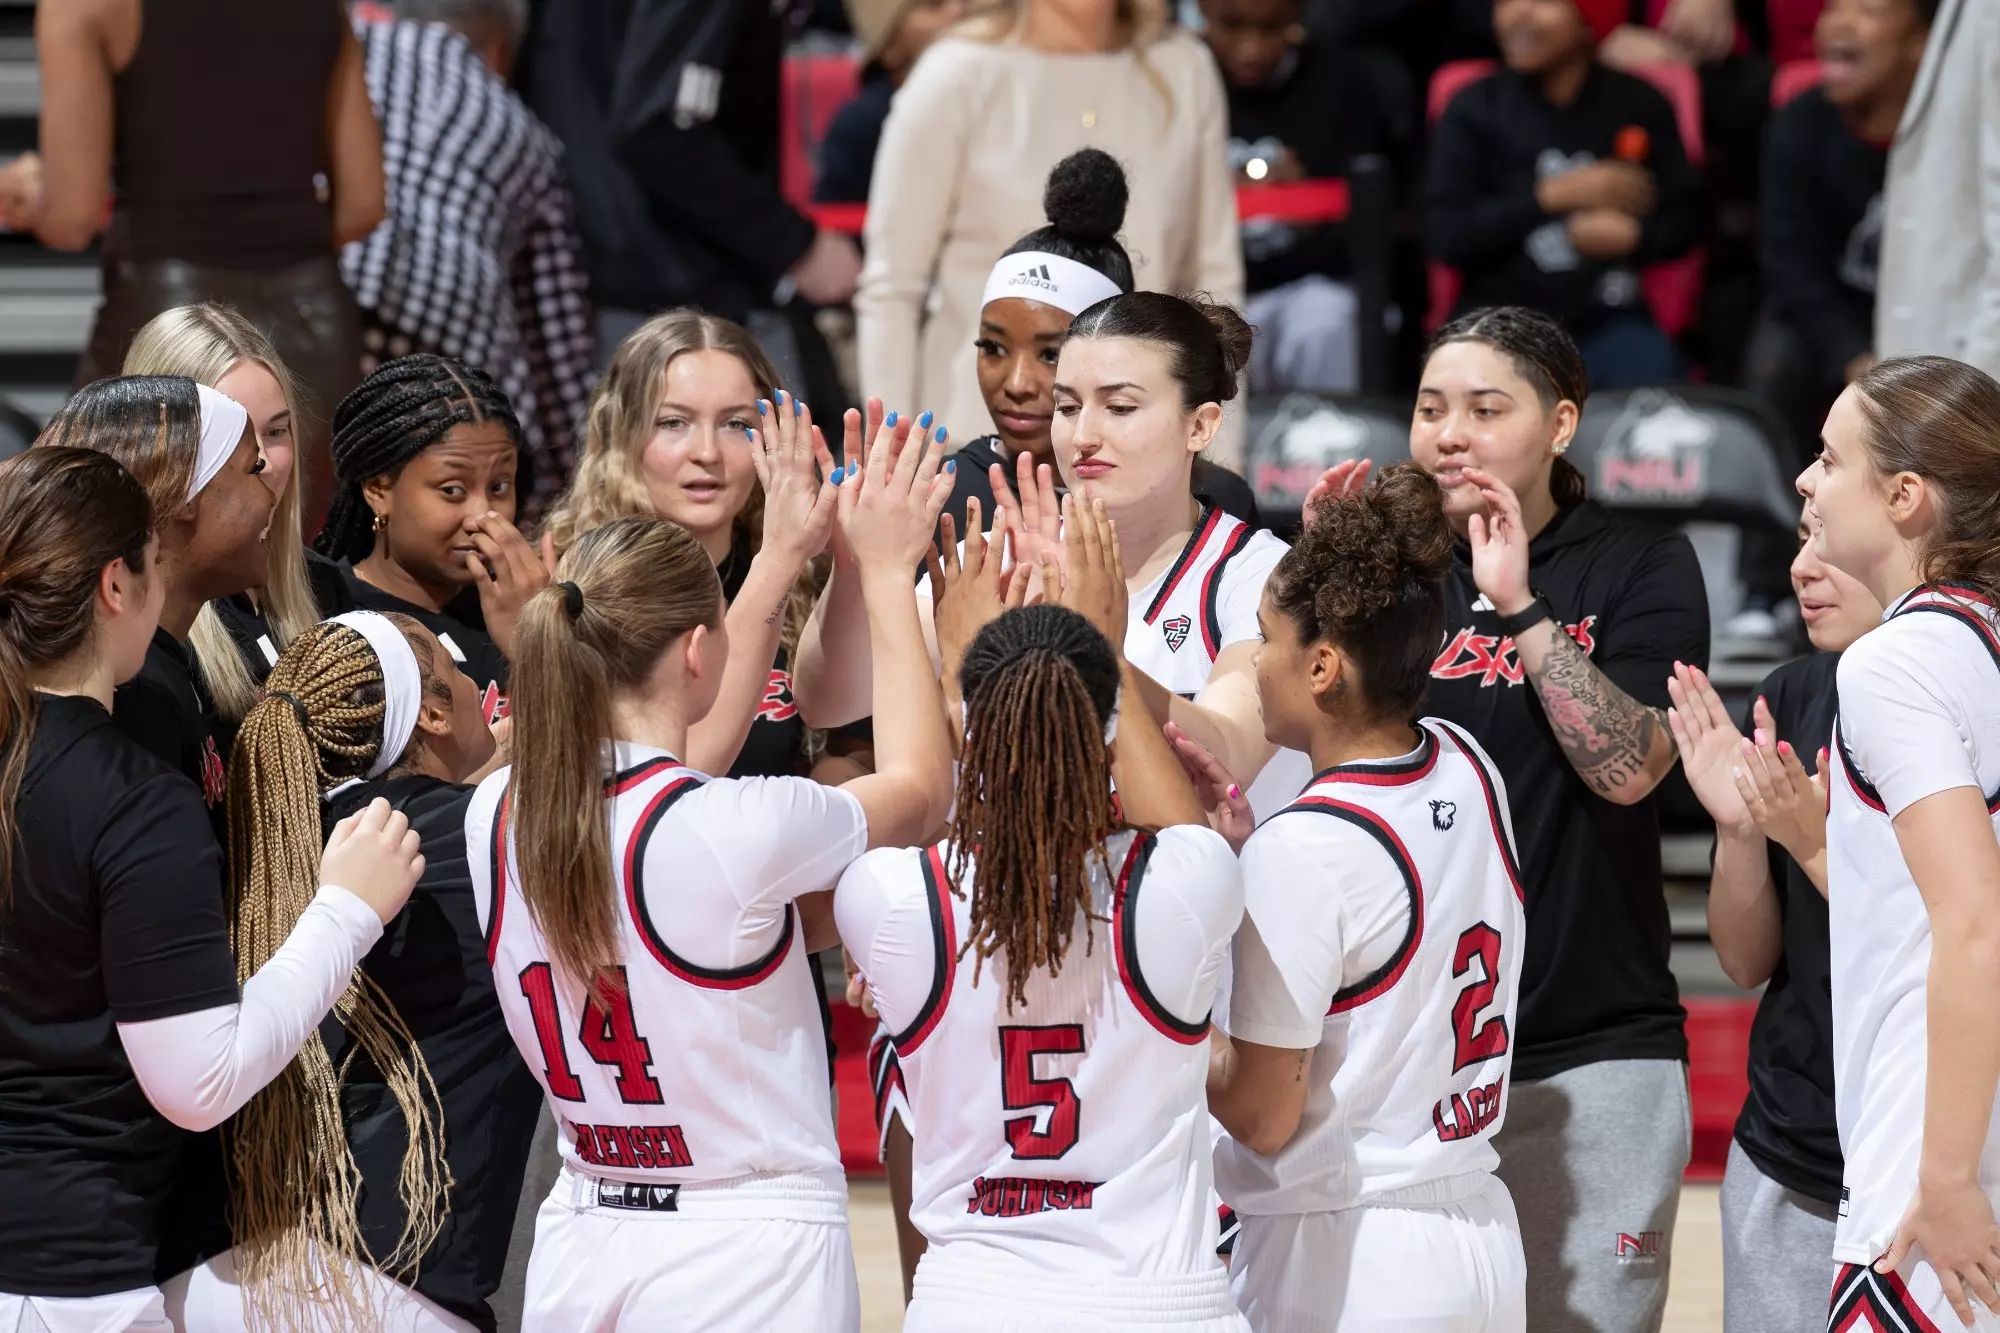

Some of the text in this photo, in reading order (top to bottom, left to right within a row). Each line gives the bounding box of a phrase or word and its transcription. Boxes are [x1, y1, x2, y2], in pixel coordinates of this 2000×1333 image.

[1008, 276, 1058, 292] adidas
[518, 961, 665, 1105] 14
[1451, 920, 1509, 1076] 2
[569, 1121, 694, 1168] RENSEN
[998, 1024, 1086, 1160] 5
